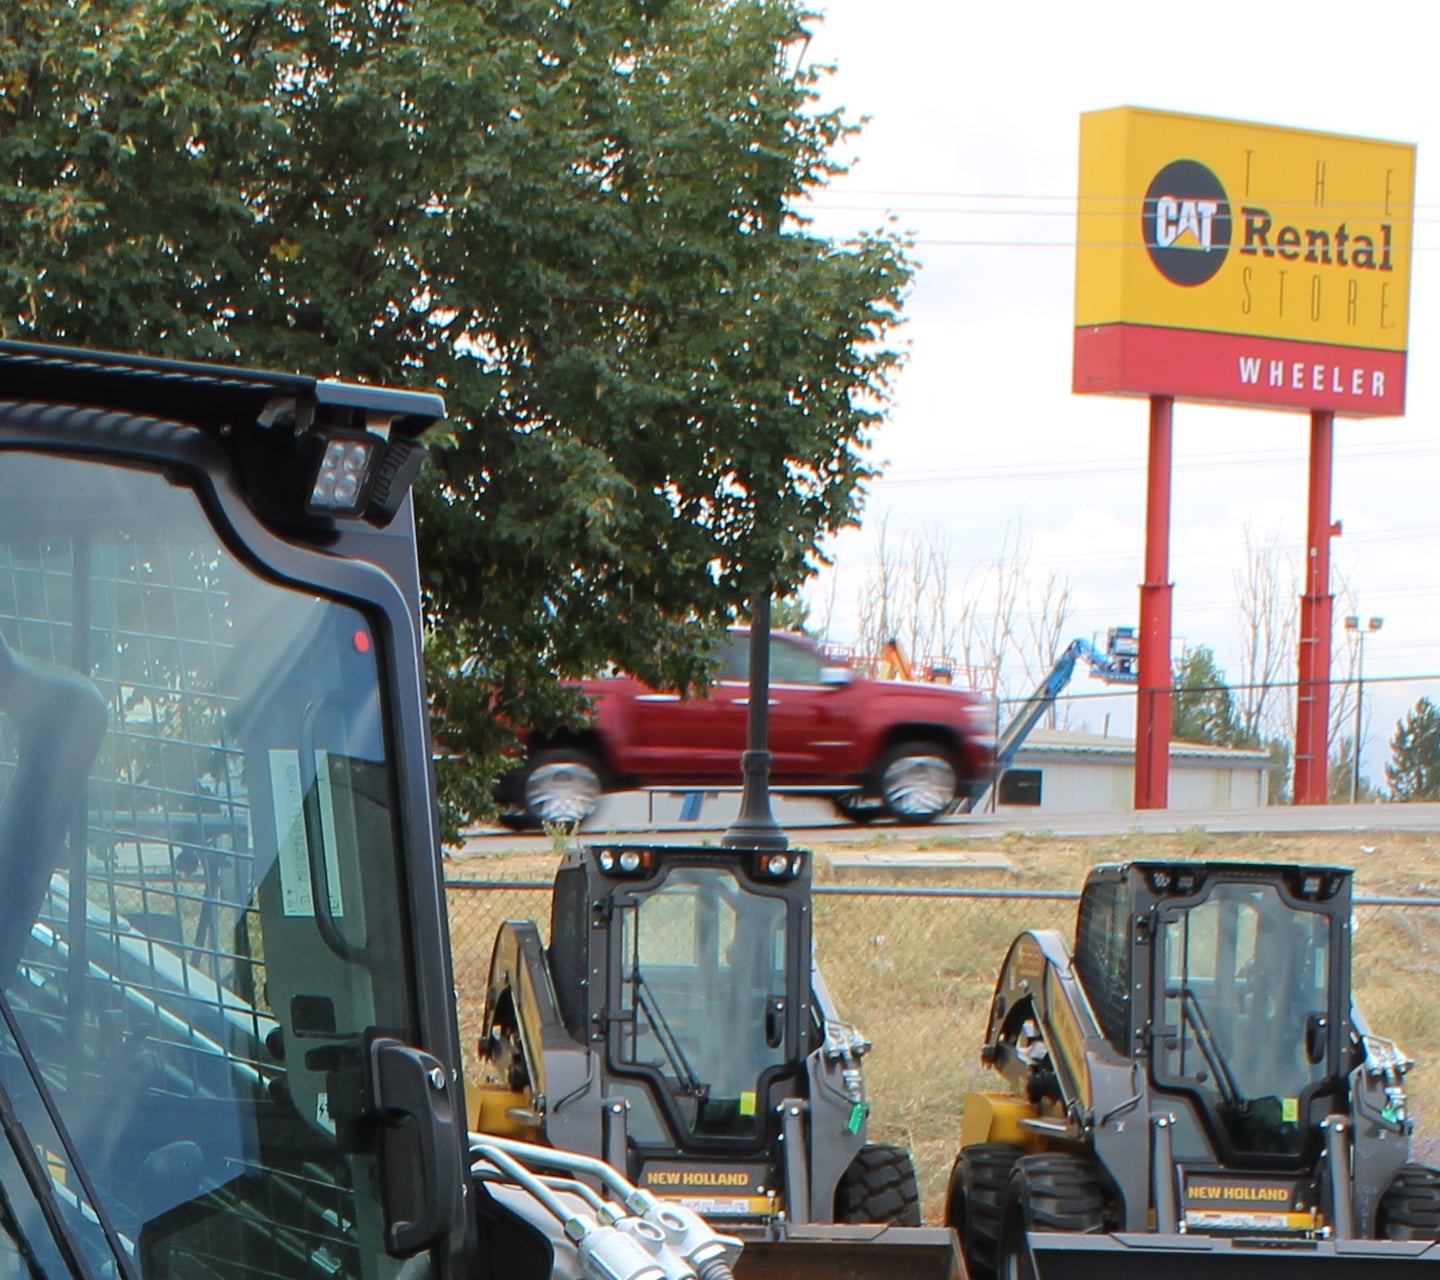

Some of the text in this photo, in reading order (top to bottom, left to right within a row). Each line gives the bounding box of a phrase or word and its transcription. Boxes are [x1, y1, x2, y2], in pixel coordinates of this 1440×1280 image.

[1243, 149, 1394, 217] THE
[1156, 195, 1217, 253] CAT
[1239, 205, 1394, 272] Rental
[1241, 266, 1390, 330] STORE
[1238, 356, 1386, 397] WHEELER
[647, 1172, 749, 1186] NEW HOLLAND
[1188, 1186, 1290, 1201] NEW HOLLAND
